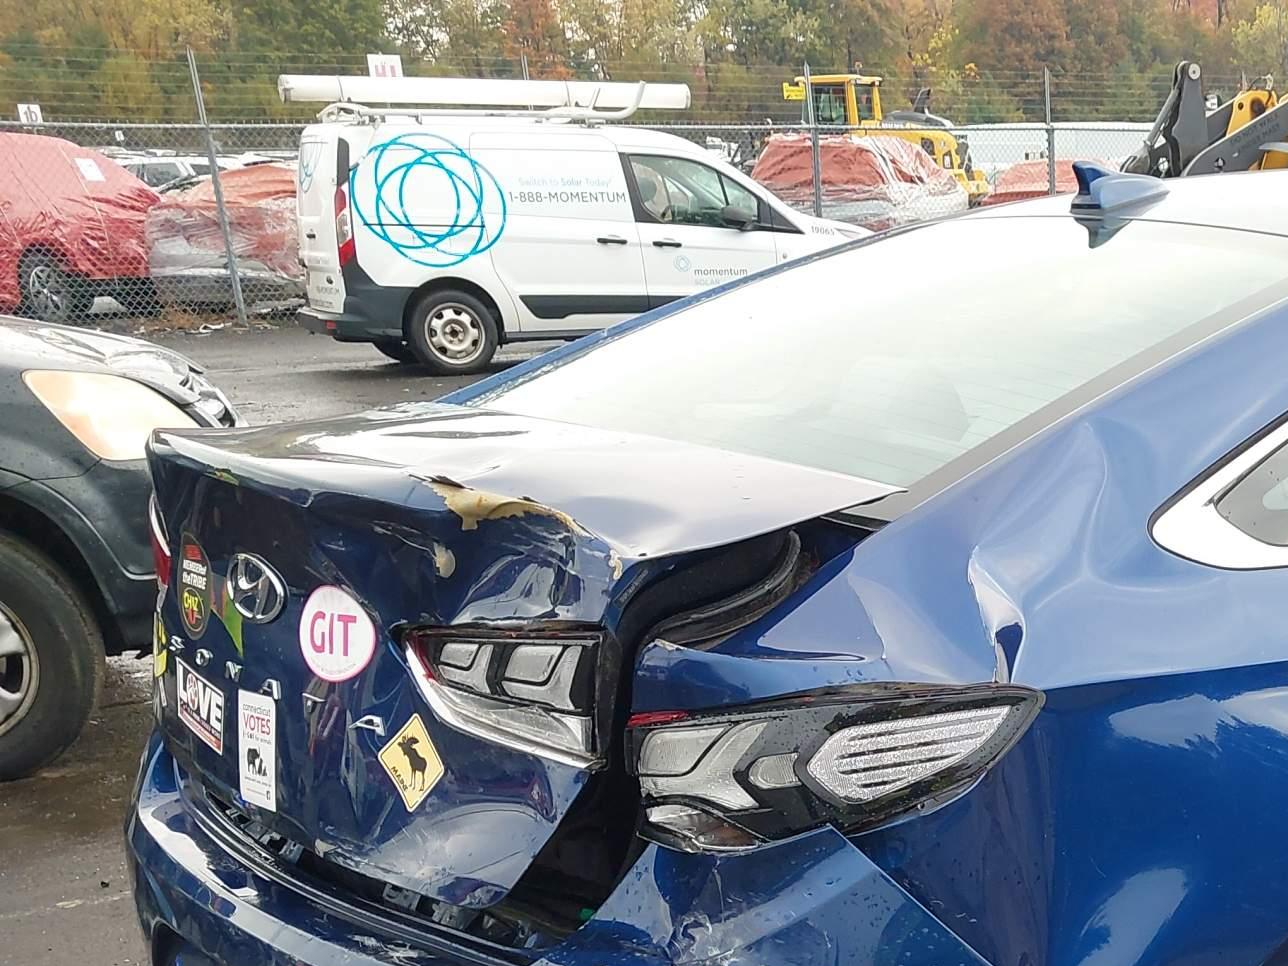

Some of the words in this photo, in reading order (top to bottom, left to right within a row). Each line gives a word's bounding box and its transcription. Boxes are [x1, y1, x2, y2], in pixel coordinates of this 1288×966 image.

[560, 177, 582, 186] Solar
[508, 191, 627, 203] 1-888-MOMENTUM
[694, 268, 748, 276] momentum
[310, 610, 357, 657] GIT
[243, 712, 271, 736] VOTES
